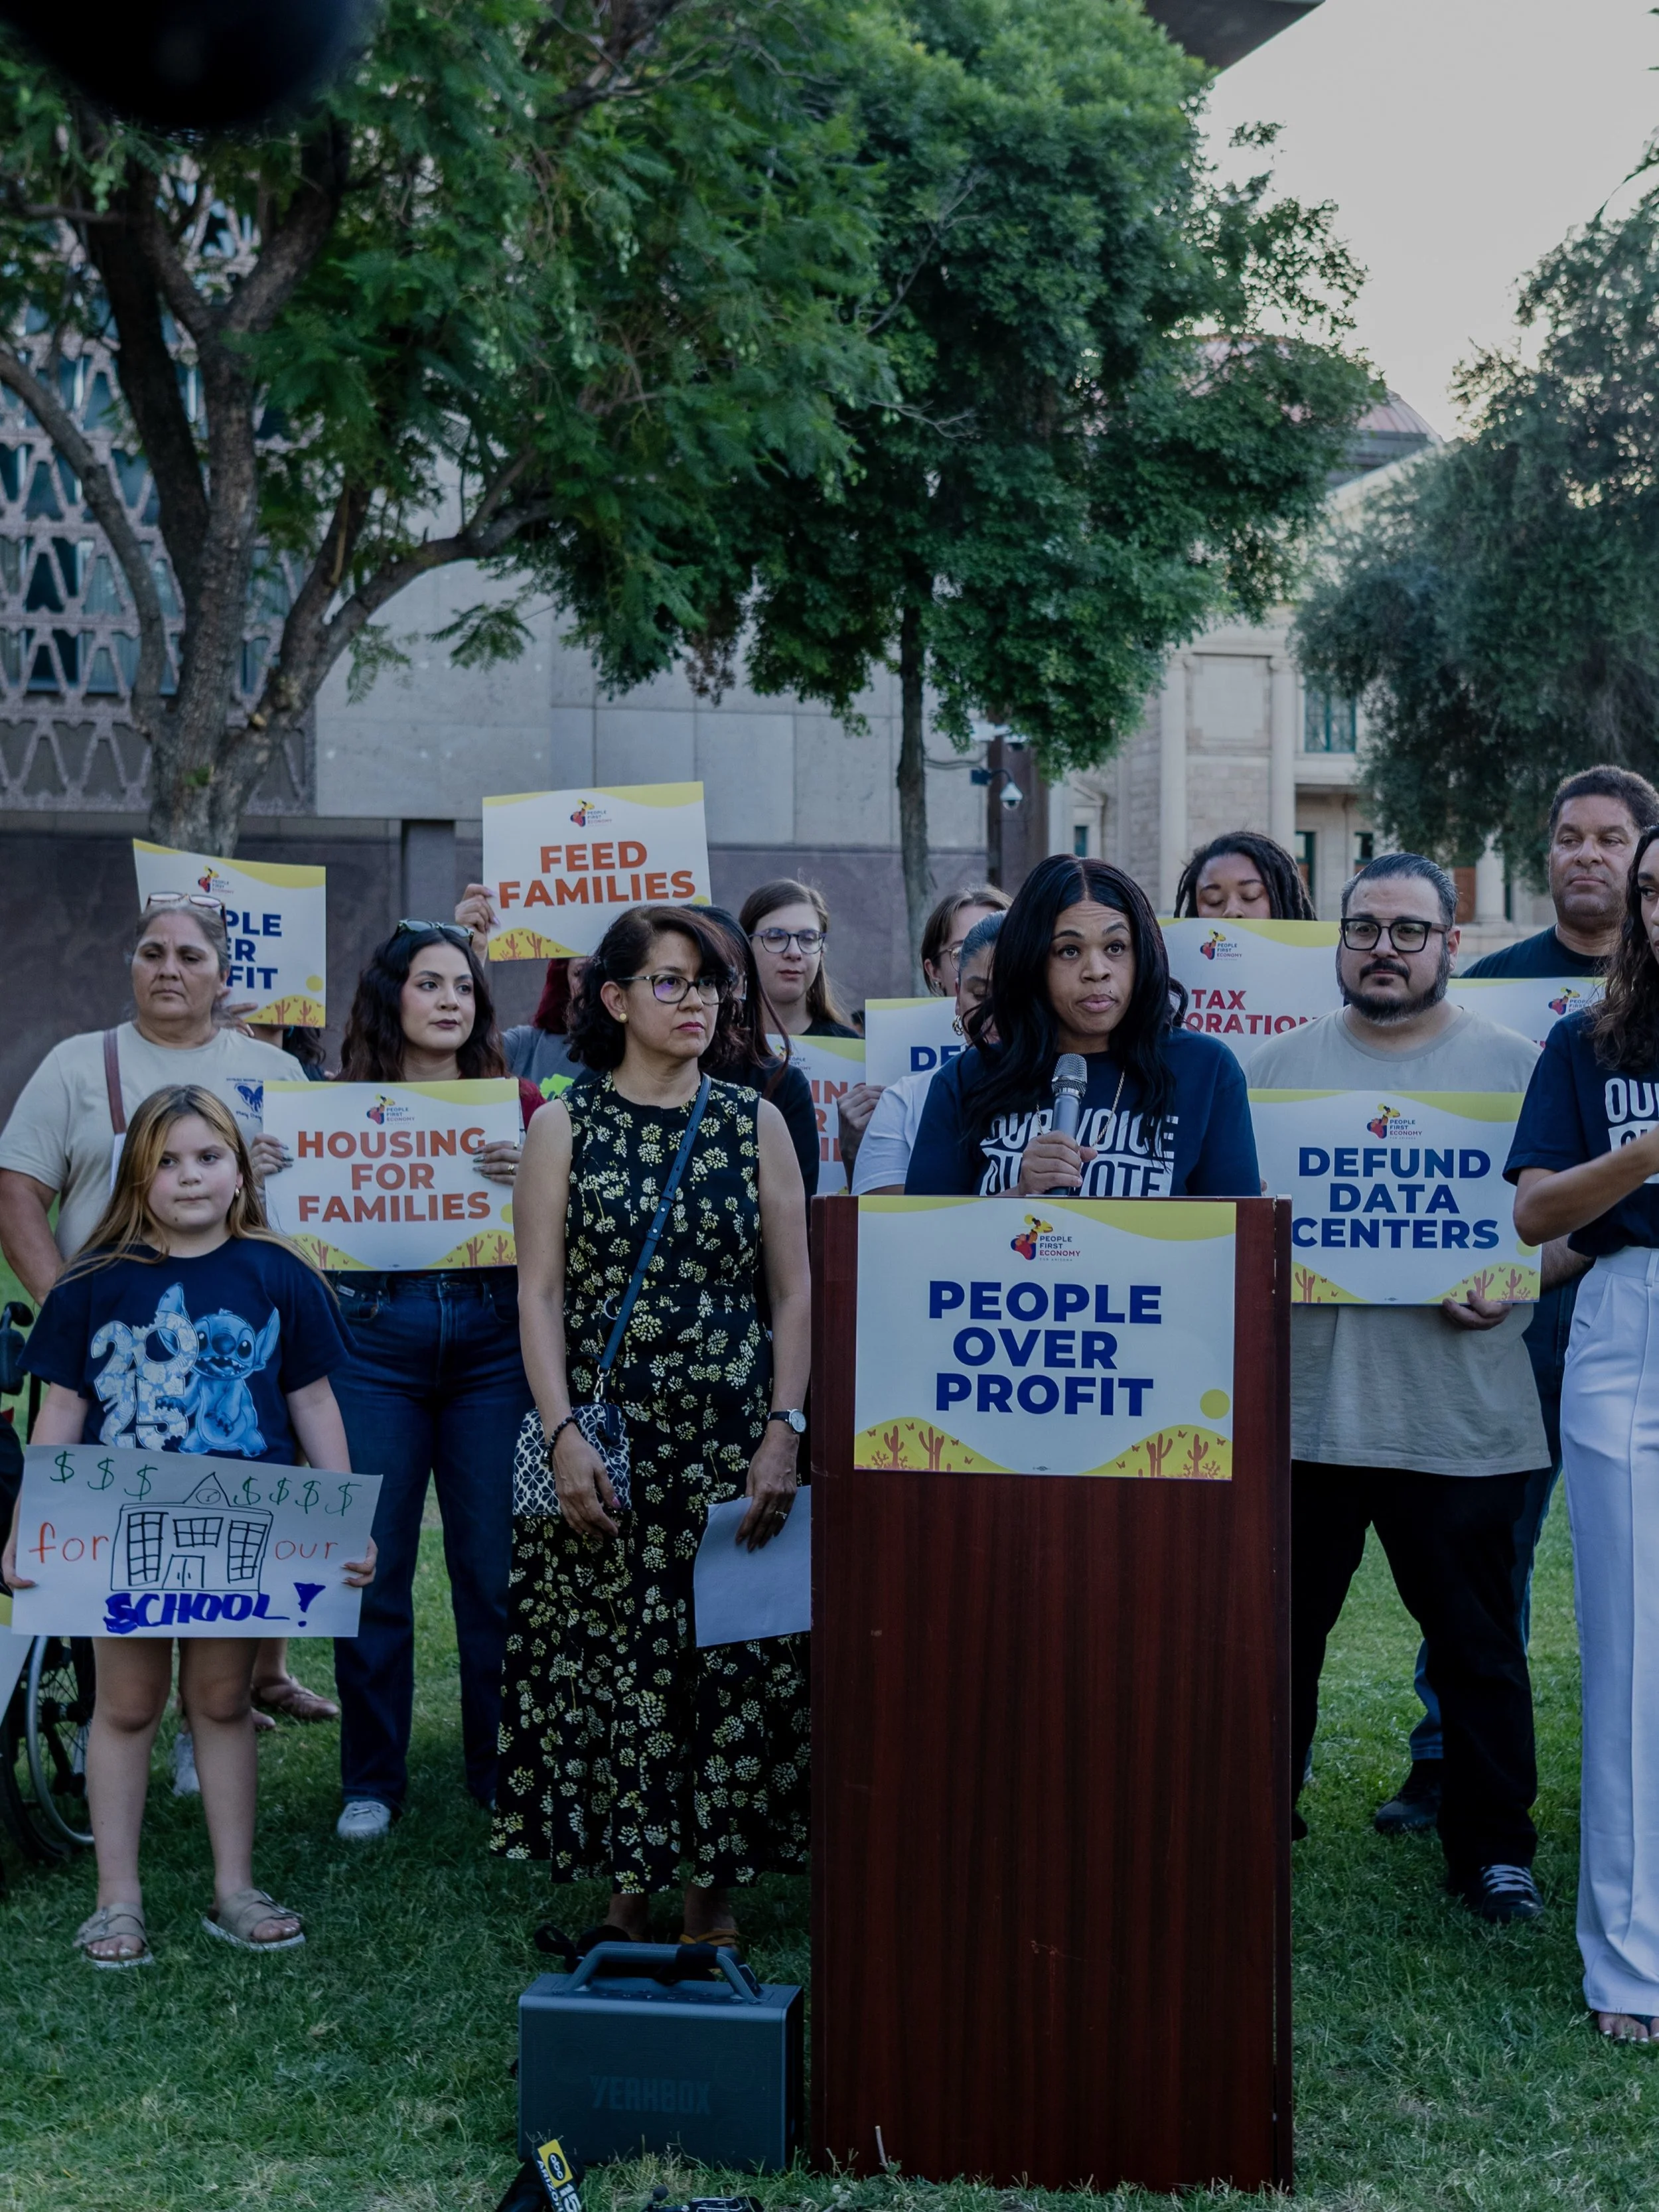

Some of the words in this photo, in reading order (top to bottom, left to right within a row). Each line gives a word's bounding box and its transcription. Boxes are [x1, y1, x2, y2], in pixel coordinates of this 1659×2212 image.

[540, 841, 647, 873] FEED
[498, 870, 695, 909] FAMILIES
[1191, 989, 1247, 1011] TAX
[1605, 1078, 1659, 1123] OU
[298, 1127, 486, 1158] HOUSING
[351, 1163, 435, 1191] FOR
[1299, 1147, 1491, 1179] DEFUND
[299, 1191, 491, 1222] FAMILIES
[1329, 1183, 1460, 1214] DATA
[1291, 1217, 1499, 1249] CENTERS
[929, 1280, 1161, 1324] PEOPLE
[953, 1327, 1118, 1369] OVER
[936, 1372, 1153, 1416] PROFIT
[29, 1521, 109, 1564] for
[275, 1540, 338, 1560] our
[549, 2154, 564, 2180] abc
